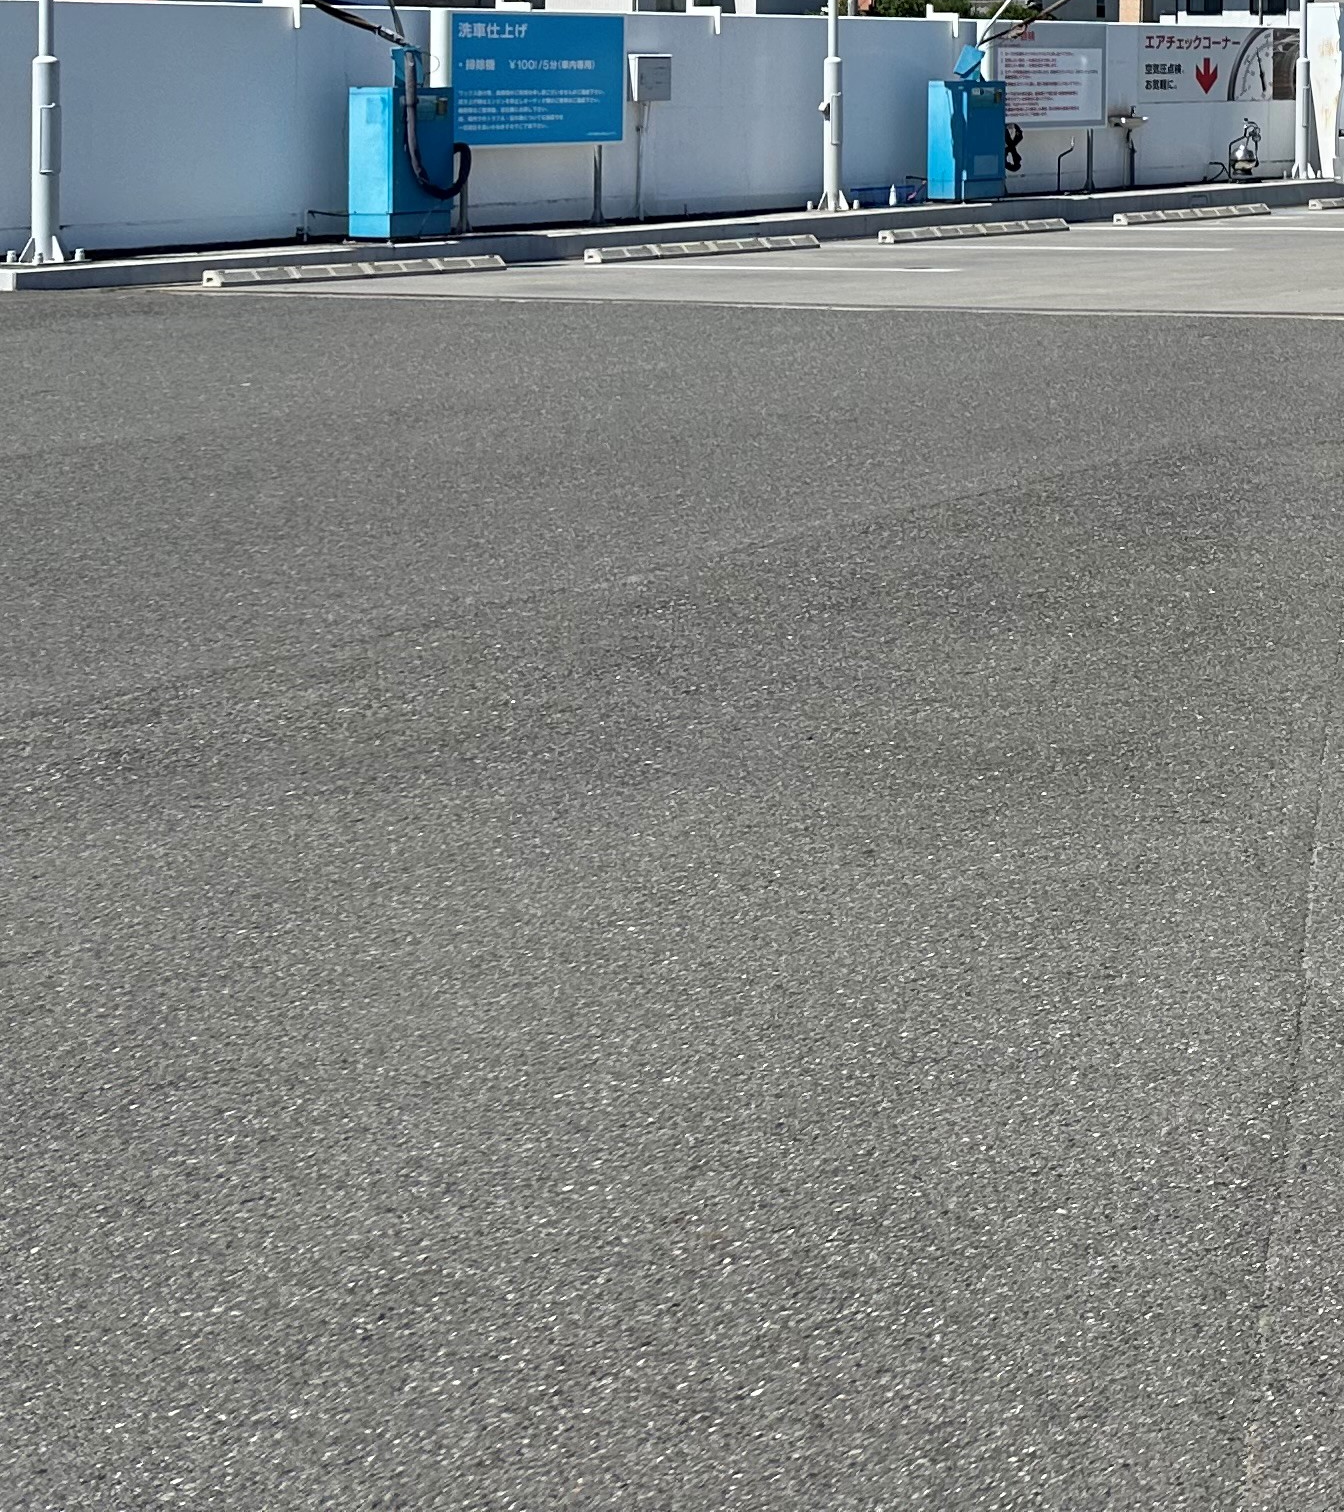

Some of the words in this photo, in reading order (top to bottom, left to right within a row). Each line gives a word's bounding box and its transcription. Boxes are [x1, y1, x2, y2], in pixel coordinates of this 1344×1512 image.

[458, 22, 528, 39] 洗車仕上げ
[1144, 35, 1241, 50] エアチェックコーナー
